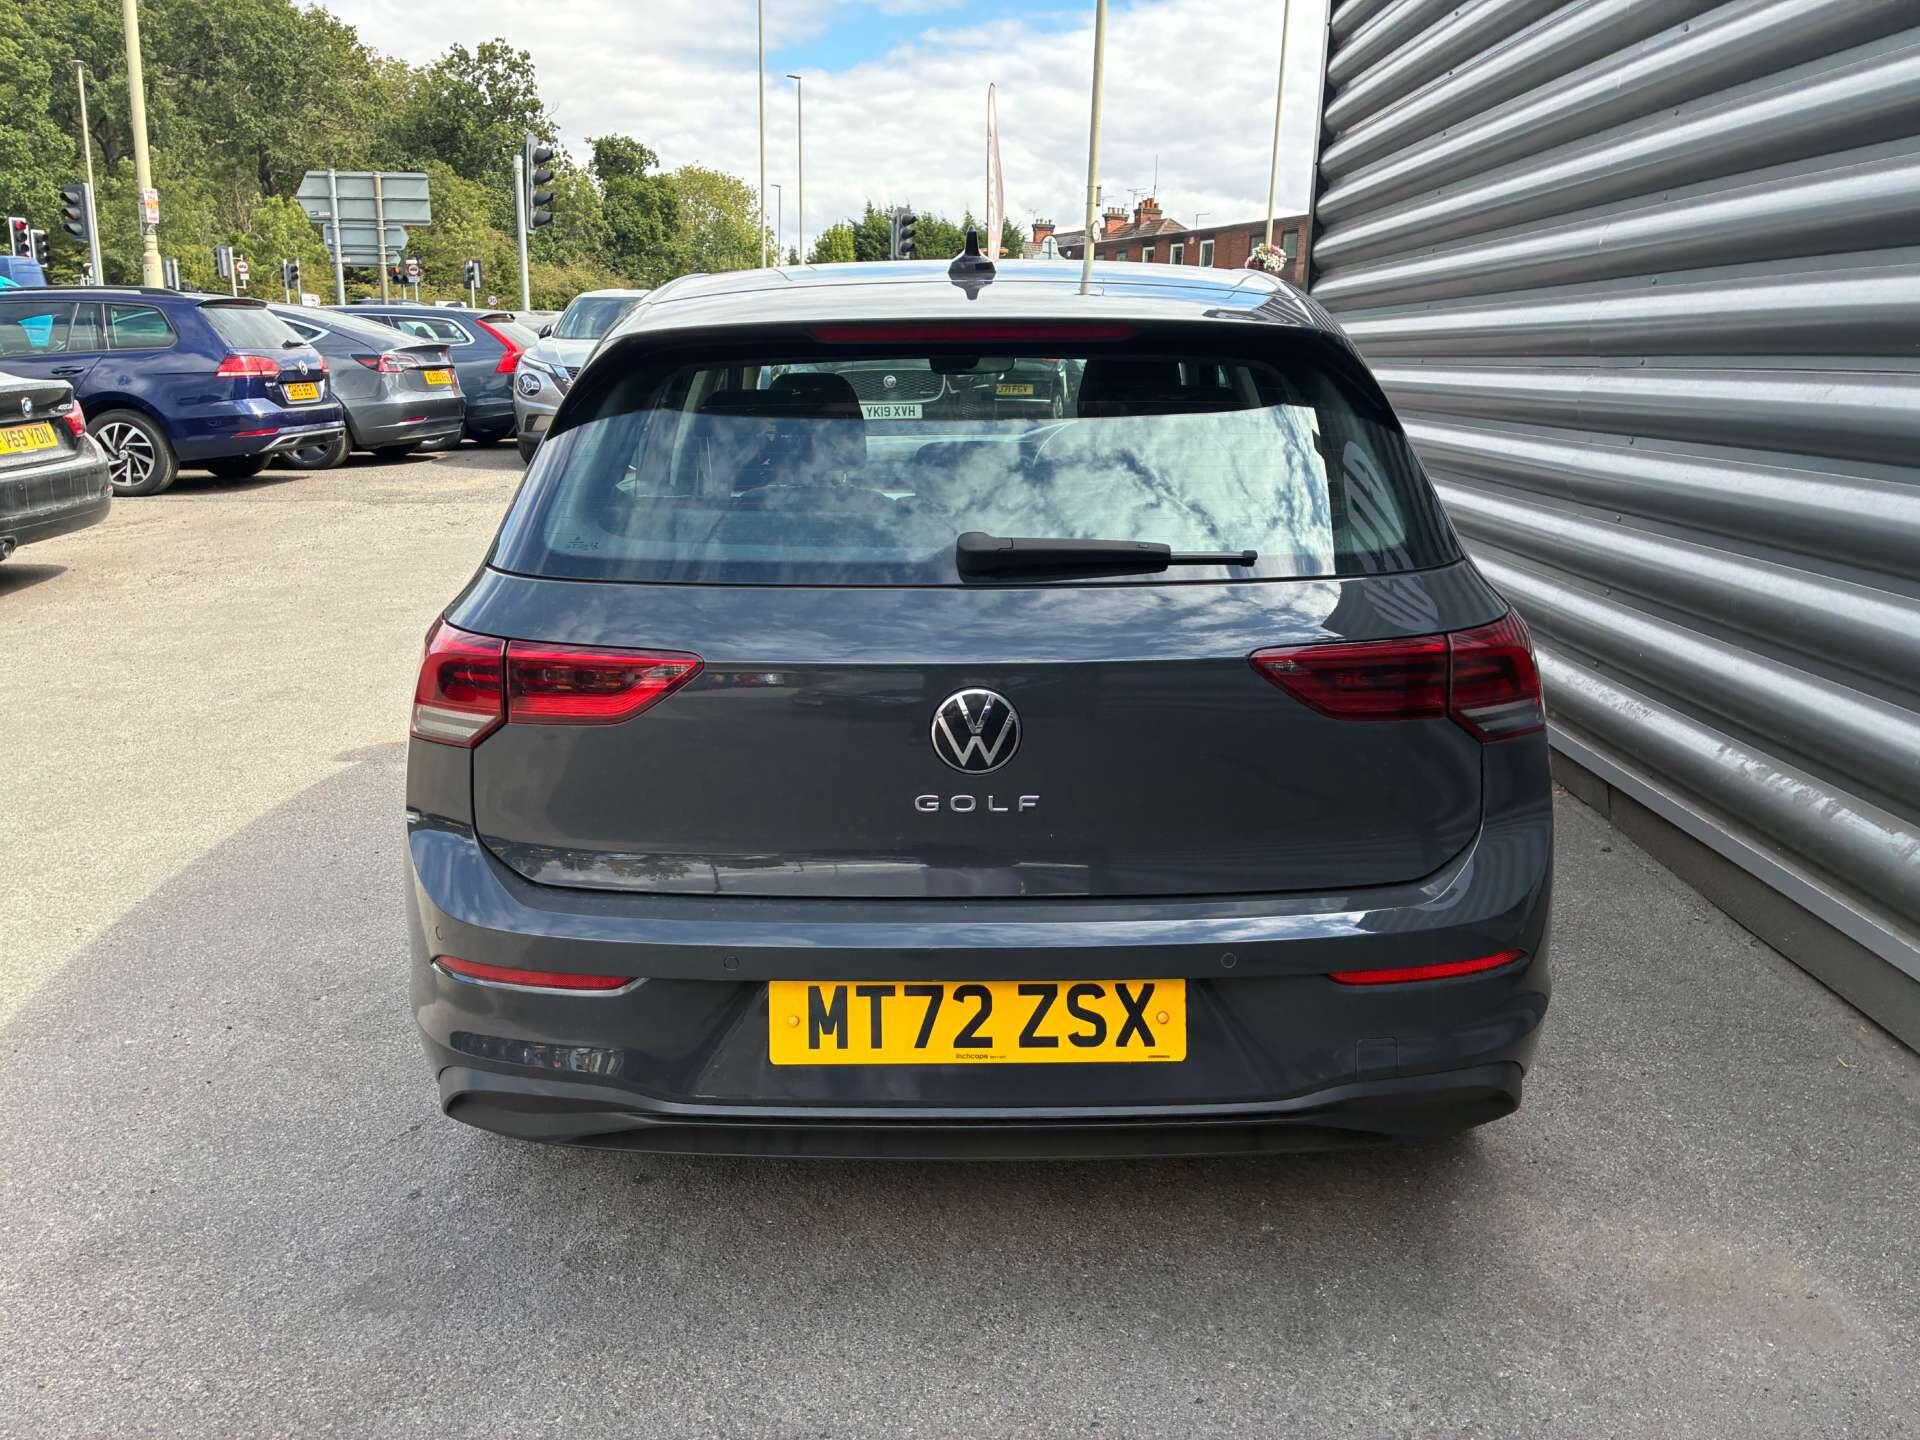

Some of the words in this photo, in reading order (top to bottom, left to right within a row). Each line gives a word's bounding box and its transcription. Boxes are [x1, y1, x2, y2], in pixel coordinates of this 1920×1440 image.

[866, 406, 891, 417] YK19
[894, 405, 916, 416] XVH
[0, 429, 29, 448] V69
[931, 688, 1021, 775] VW
[914, 794, 1041, 813] GOLF
[807, 983, 993, 1050] MT72
[1017, 983, 1156, 1049] ZSX
